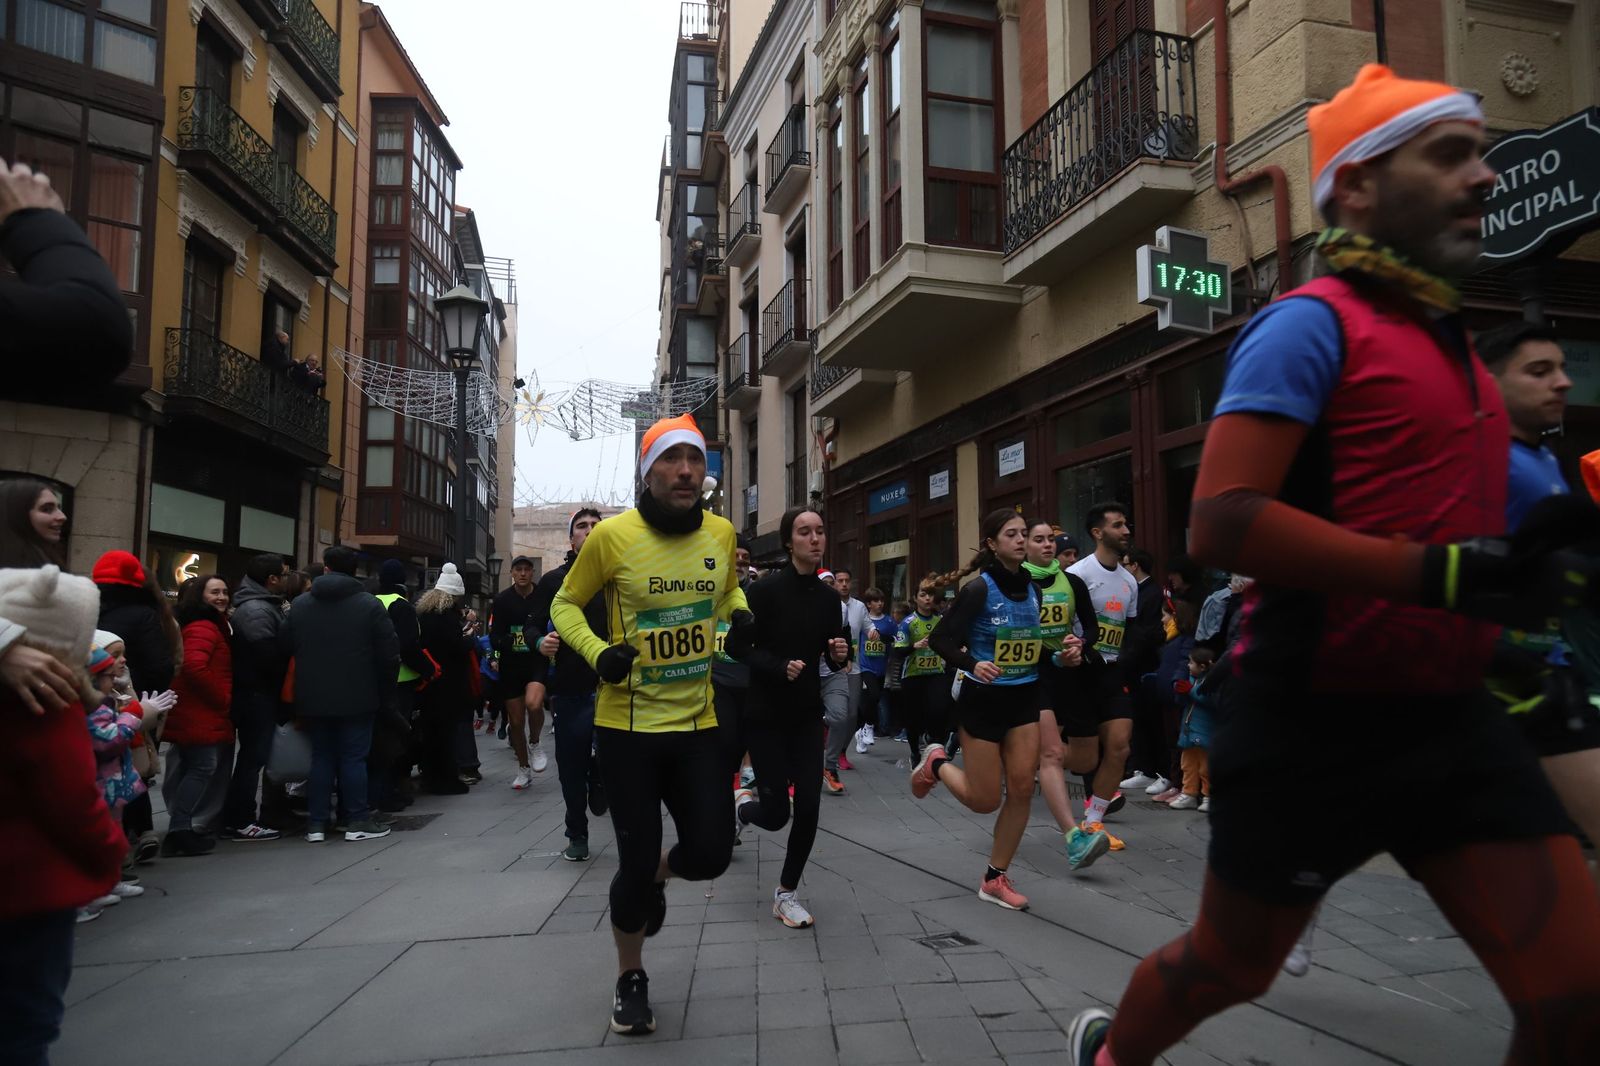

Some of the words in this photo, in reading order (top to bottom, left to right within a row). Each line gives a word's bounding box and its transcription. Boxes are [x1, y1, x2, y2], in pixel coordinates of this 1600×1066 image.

[1484, 149, 1561, 201] ATRO
[1480, 179, 1585, 239] INCIPAL
[1157, 262, 1221, 298] 17:30
[880, 490, 899, 503] NUXE
[1041, 605, 1063, 623] 28
[645, 624, 705, 660] 1086
[866, 643, 883, 652] 605
[998, 642, 1035, 662] 295
[665, 667, 686, 678] CAJA
[688, 662, 709, 674] RURA
[919, 657, 938, 667] 278
